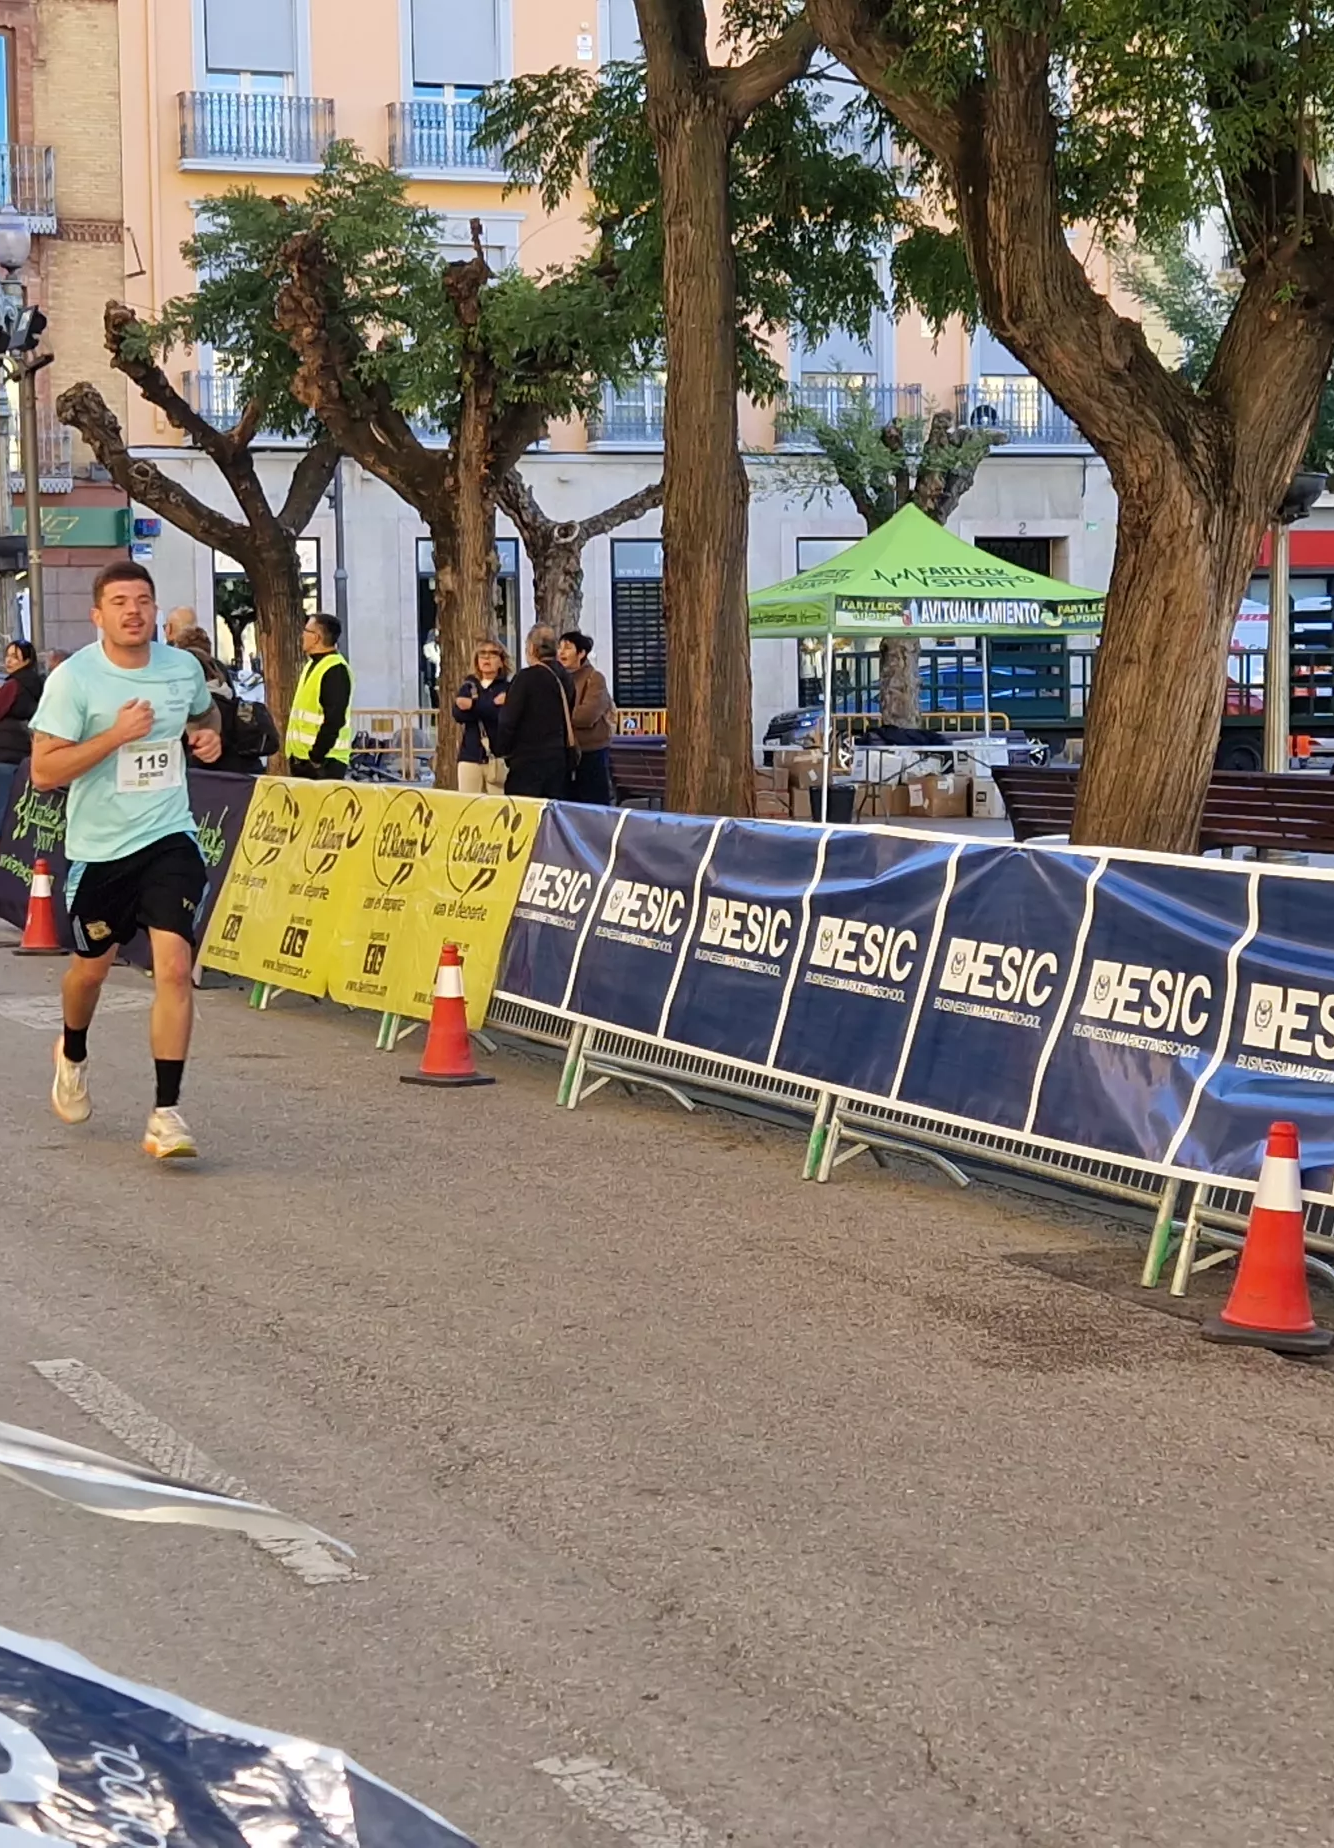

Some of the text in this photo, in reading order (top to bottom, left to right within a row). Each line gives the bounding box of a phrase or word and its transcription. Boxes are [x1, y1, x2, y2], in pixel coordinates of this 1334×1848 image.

[1019, 522, 1027, 535] 2
[921, 600, 1040, 624] AVITUALLAMIENTO
[1057, 602, 1105, 614] FARTLEC
[134, 753, 168, 770] 119
[535, 864, 592, 914] ESIC
[620, 881, 685, 936] ESIC
[721, 900, 792, 958] ESIC
[834, 920, 917, 982] ESIC
[968, 942, 1058, 1007] ESIC
[1111, 965, 1212, 1037] ESIC
